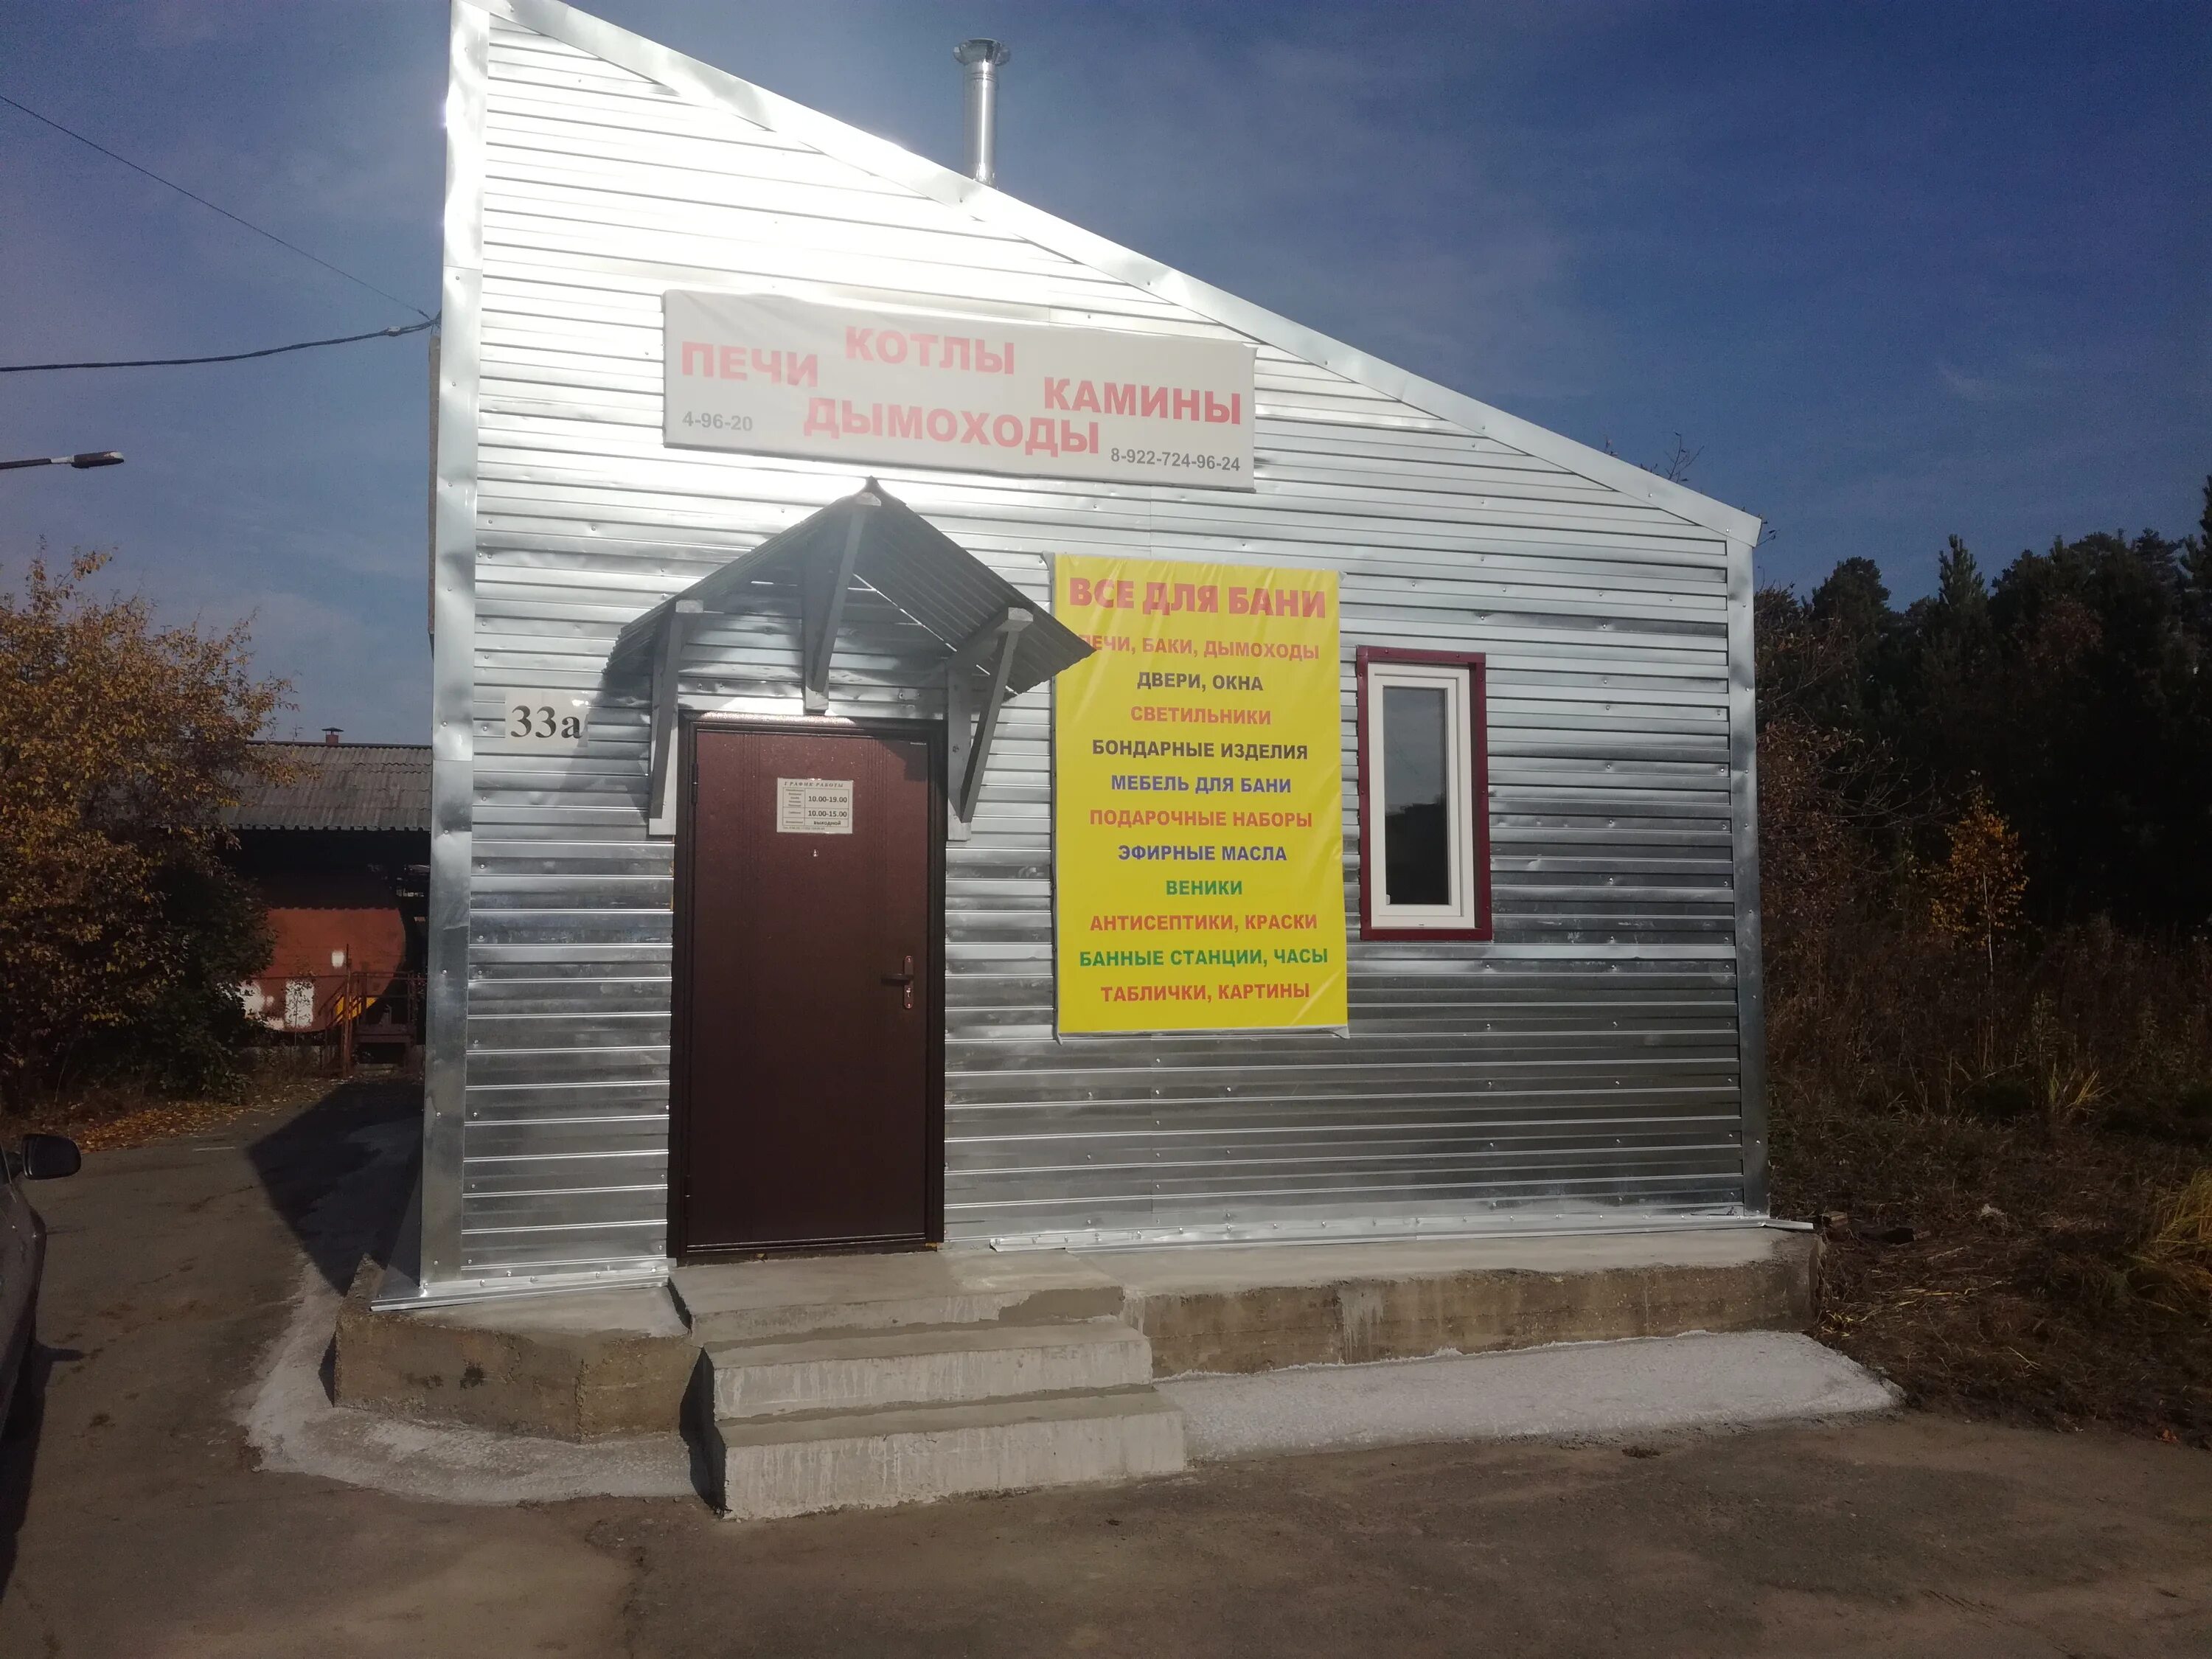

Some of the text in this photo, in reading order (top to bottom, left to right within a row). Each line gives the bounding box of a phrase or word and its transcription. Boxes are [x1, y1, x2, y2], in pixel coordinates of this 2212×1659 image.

[846, 326, 1015, 375] КОТЛЫ
[681, 341, 818, 387] ПЕЧИ
[1044, 376, 1241, 425] КАМИНЫ
[682, 411, 754, 431] 4-96-20
[804, 397, 1099, 456] ДЫМОХОДЫ
[1110, 447, 1240, 472] 8-922-724-96-24
[1070, 577, 1326, 618] ВСЕ ДЛЯ БАНИ
[1143, 639, 1197, 657] БАКИ,
[1204, 640, 1319, 661] ДЫМОХОДЫ
[1137, 672, 1263, 692] ДВЕРИ, ОКНА
[1131, 706, 1271, 725] СВЕТИЛЬНИКИ
[1093, 739, 1307, 761] БОНДАРНЫЕ ИЗДЕЛИЯ
[1112, 774, 1291, 793] МЕБЕЛЬ ДЛЯ БАНИ
[1090, 810, 1312, 828] ПОДАРОЧНЫЕ НАБОРЫ
[1118, 845, 1287, 861] ЭФИРНЫЕ МАСЛА
[1166, 880, 1242, 896] ВЕНИКИ
[1091, 914, 1317, 933] АНТИСЕПТИКИ, КРАСКИ
[1080, 947, 1328, 967] БАННЫЕ СТАНЦИИ, ЧАСЫ
[1102, 983, 1310, 1003] ТАБЛИЧКИ, КАРТИНЫ
